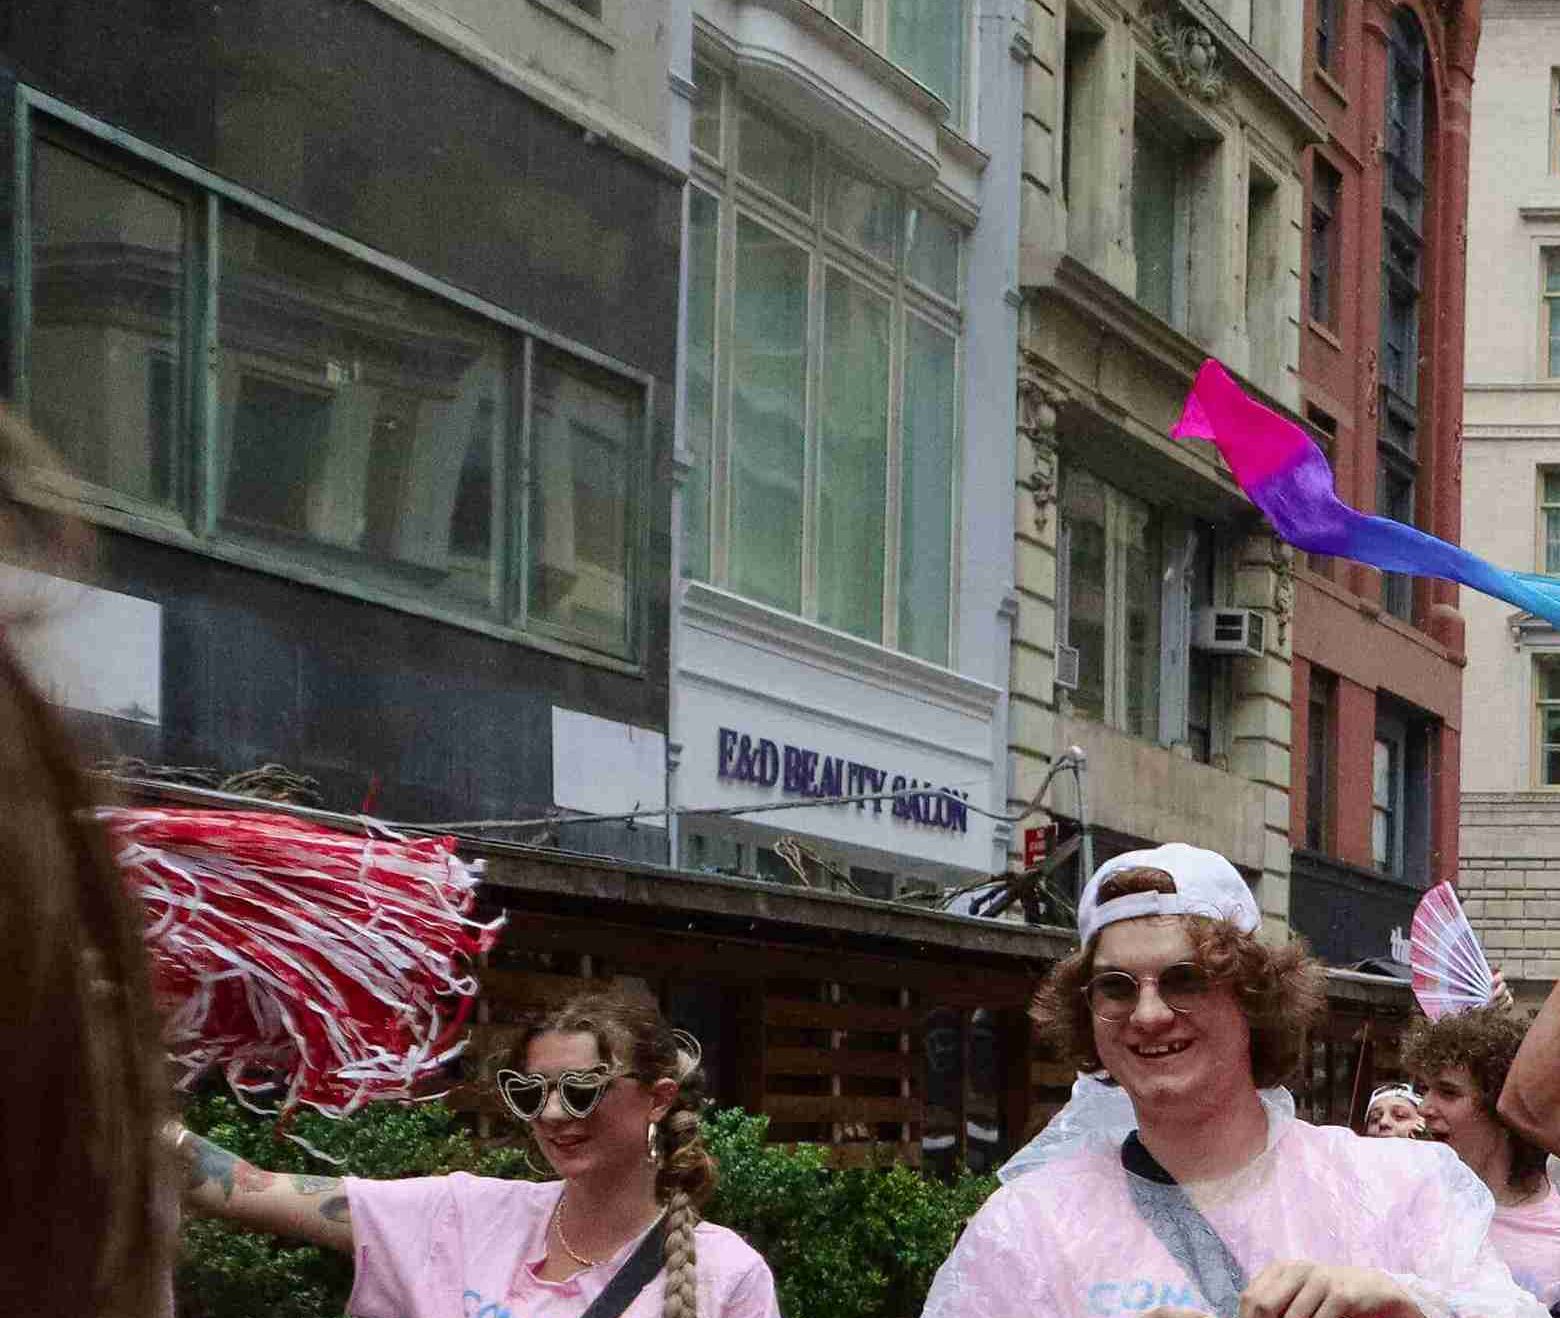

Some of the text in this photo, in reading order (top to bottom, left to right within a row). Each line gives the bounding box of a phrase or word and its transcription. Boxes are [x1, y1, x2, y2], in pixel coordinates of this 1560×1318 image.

[718, 727, 969, 833] E&D BEAUTY SALON
